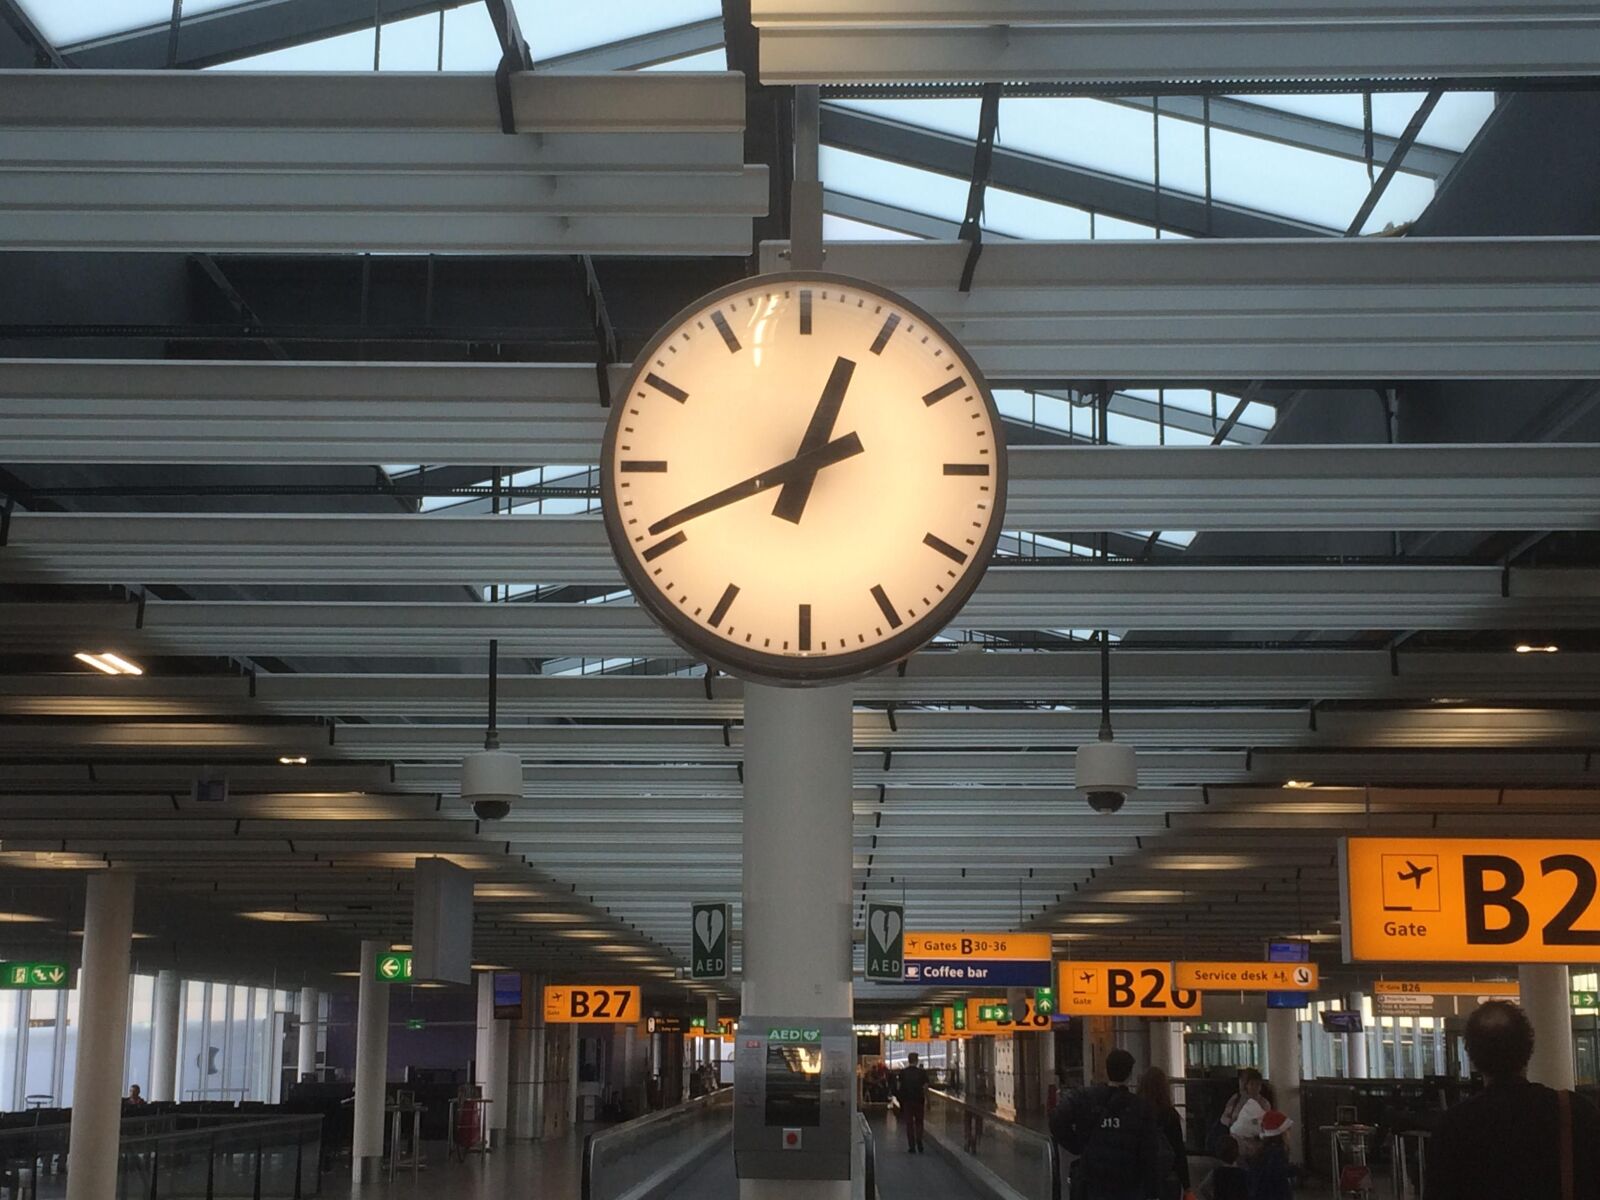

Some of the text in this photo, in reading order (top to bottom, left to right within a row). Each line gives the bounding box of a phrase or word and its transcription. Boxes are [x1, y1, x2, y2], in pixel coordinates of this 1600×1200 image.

[1383, 921, 1427, 937] Gate
[924, 940, 957, 951] Gates
[696, 958, 724, 972] AED
[871, 959, 900, 973] AED
[923, 966, 989, 978] Coffee bar
[1195, 969, 1268, 981] Service desk
[1401, 983, 1421, 993] B26
[570, 989, 631, 1018] B27
[769, 1029, 800, 1040] AED
